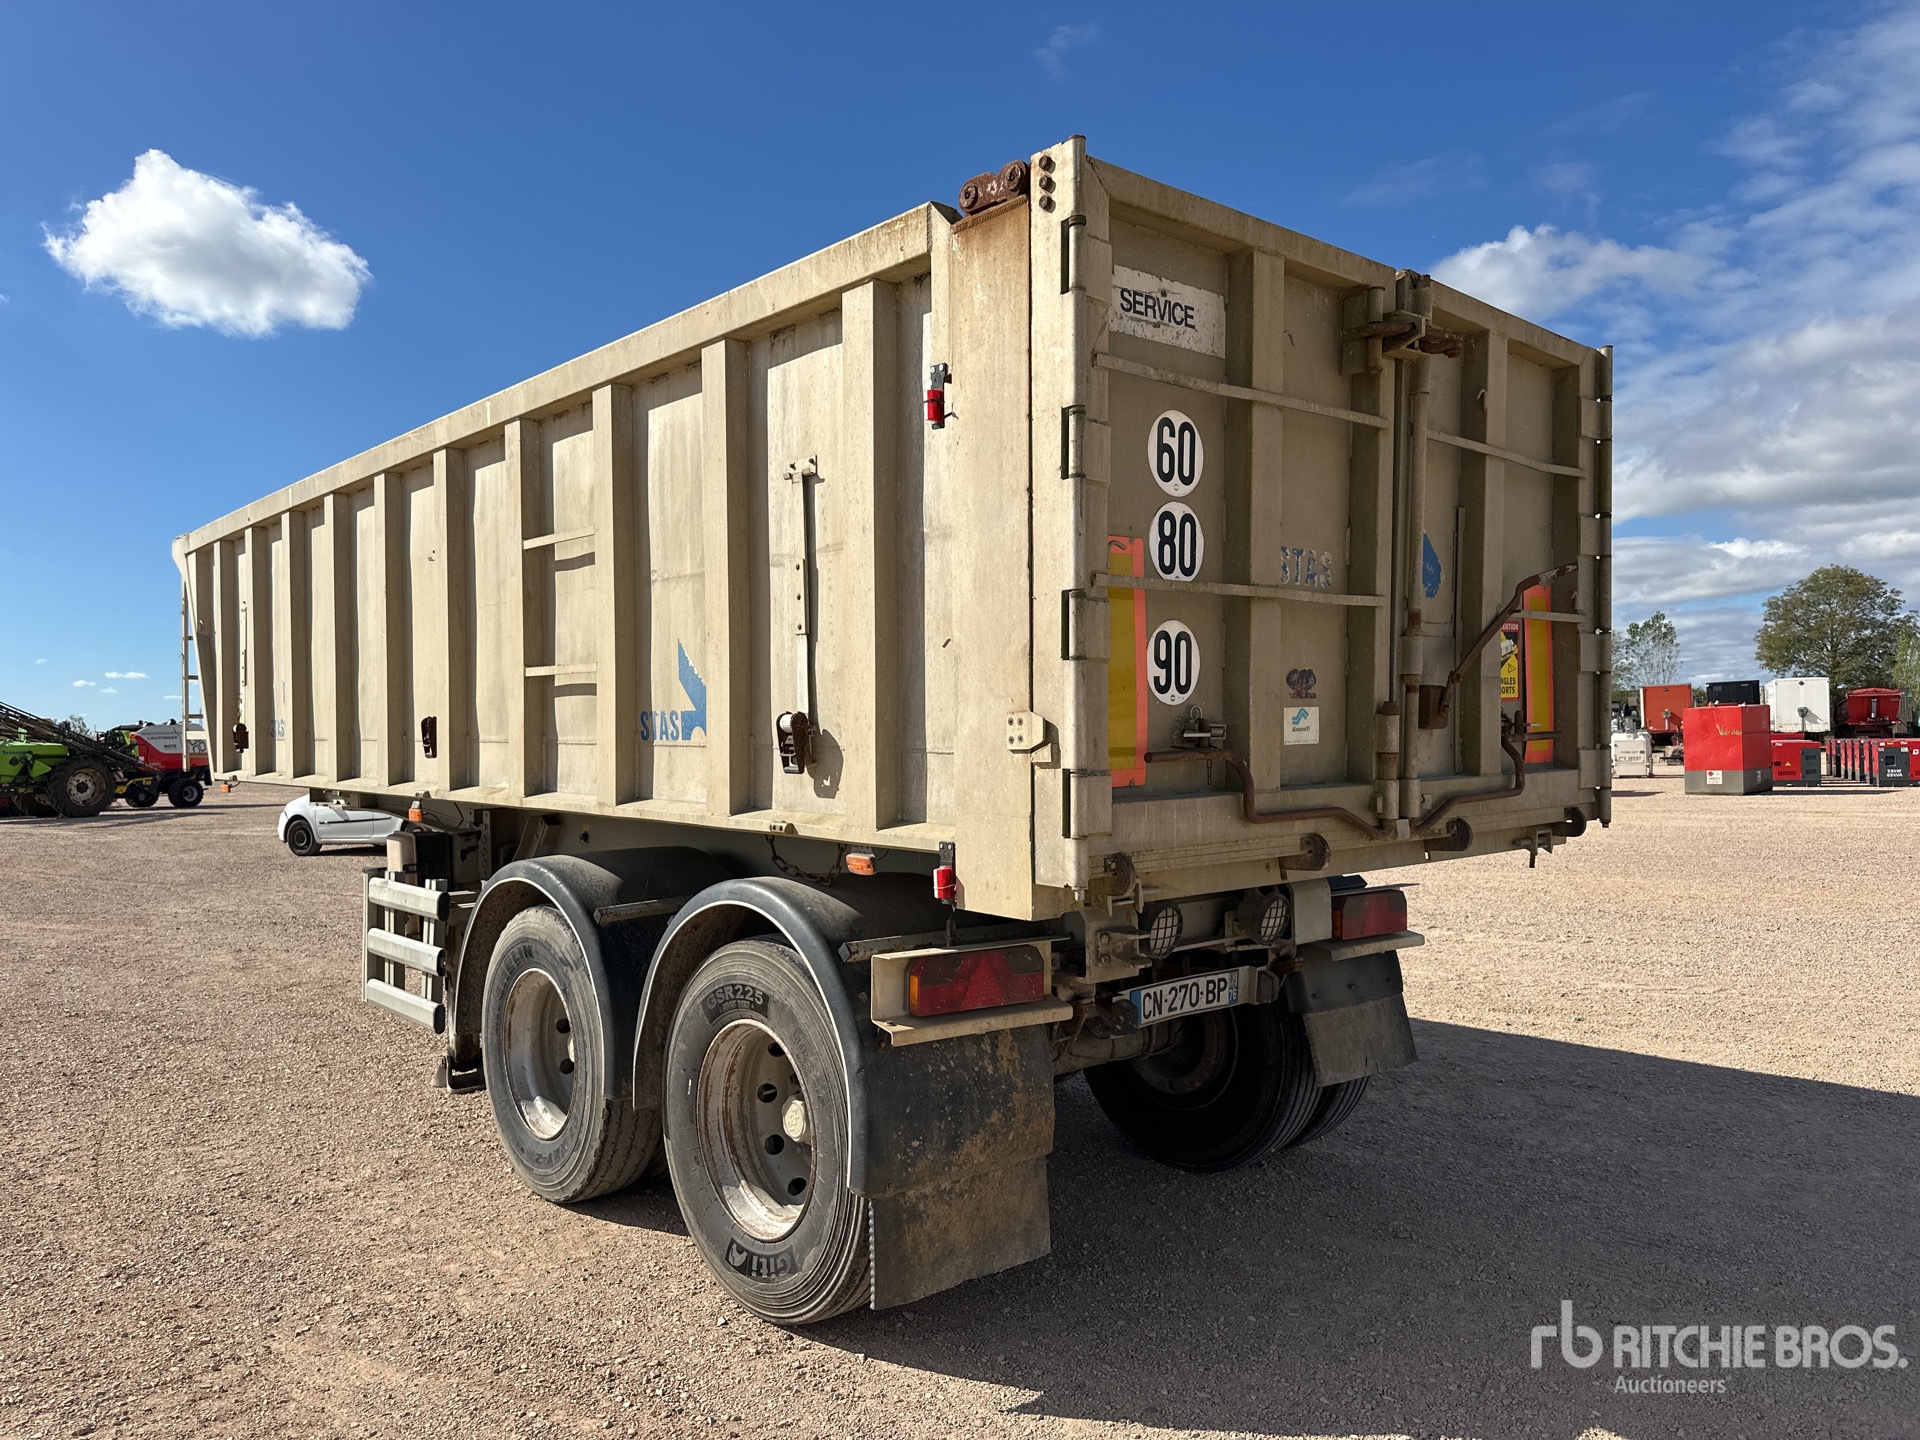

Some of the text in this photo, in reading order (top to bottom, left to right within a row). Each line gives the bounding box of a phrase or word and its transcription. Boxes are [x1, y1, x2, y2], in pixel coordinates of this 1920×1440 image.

[1120, 287, 1196, 330] SERVICE
[1156, 416, 1196, 487] 60
[1157, 510, 1197, 577] 80
[1280, 546, 1333, 588] STAS
[1153, 629, 1193, 695] 90
[1501, 677, 1516, 685] NGLES
[1501, 686, 1516, 694] ORTS
[641, 709, 680, 741] STAS
[706, 985, 764, 1010] GSR225
[1228, 988, 1237, 1001] 76
